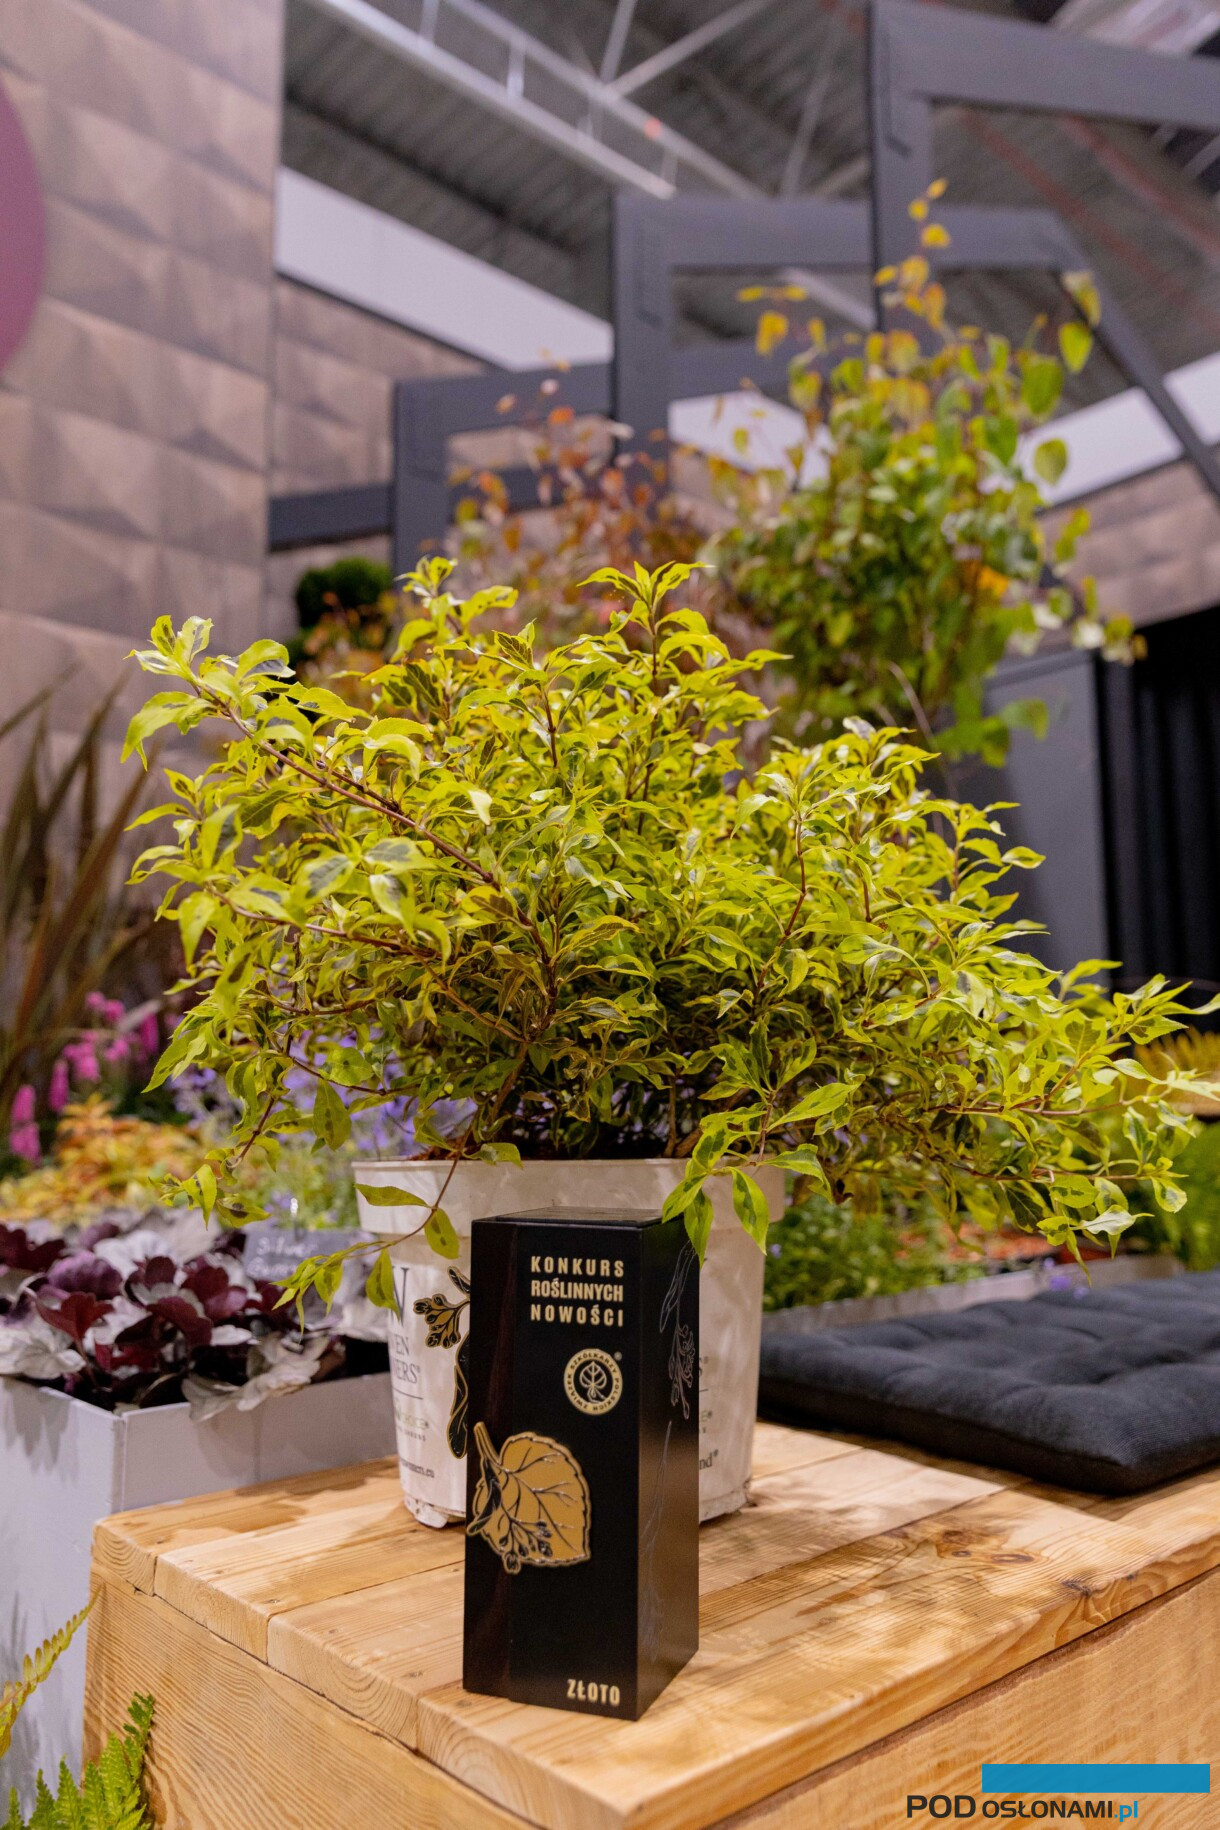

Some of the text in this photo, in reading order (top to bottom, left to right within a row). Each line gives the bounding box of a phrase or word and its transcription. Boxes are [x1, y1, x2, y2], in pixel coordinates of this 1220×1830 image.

[531, 1256, 624, 1277] KONKURS
[531, 1278, 624, 1302] ROŚLINNYCH
[530, 1304, 624, 1327] NOWOŚCI
[566, 1678, 621, 1707] ZŁOTO
